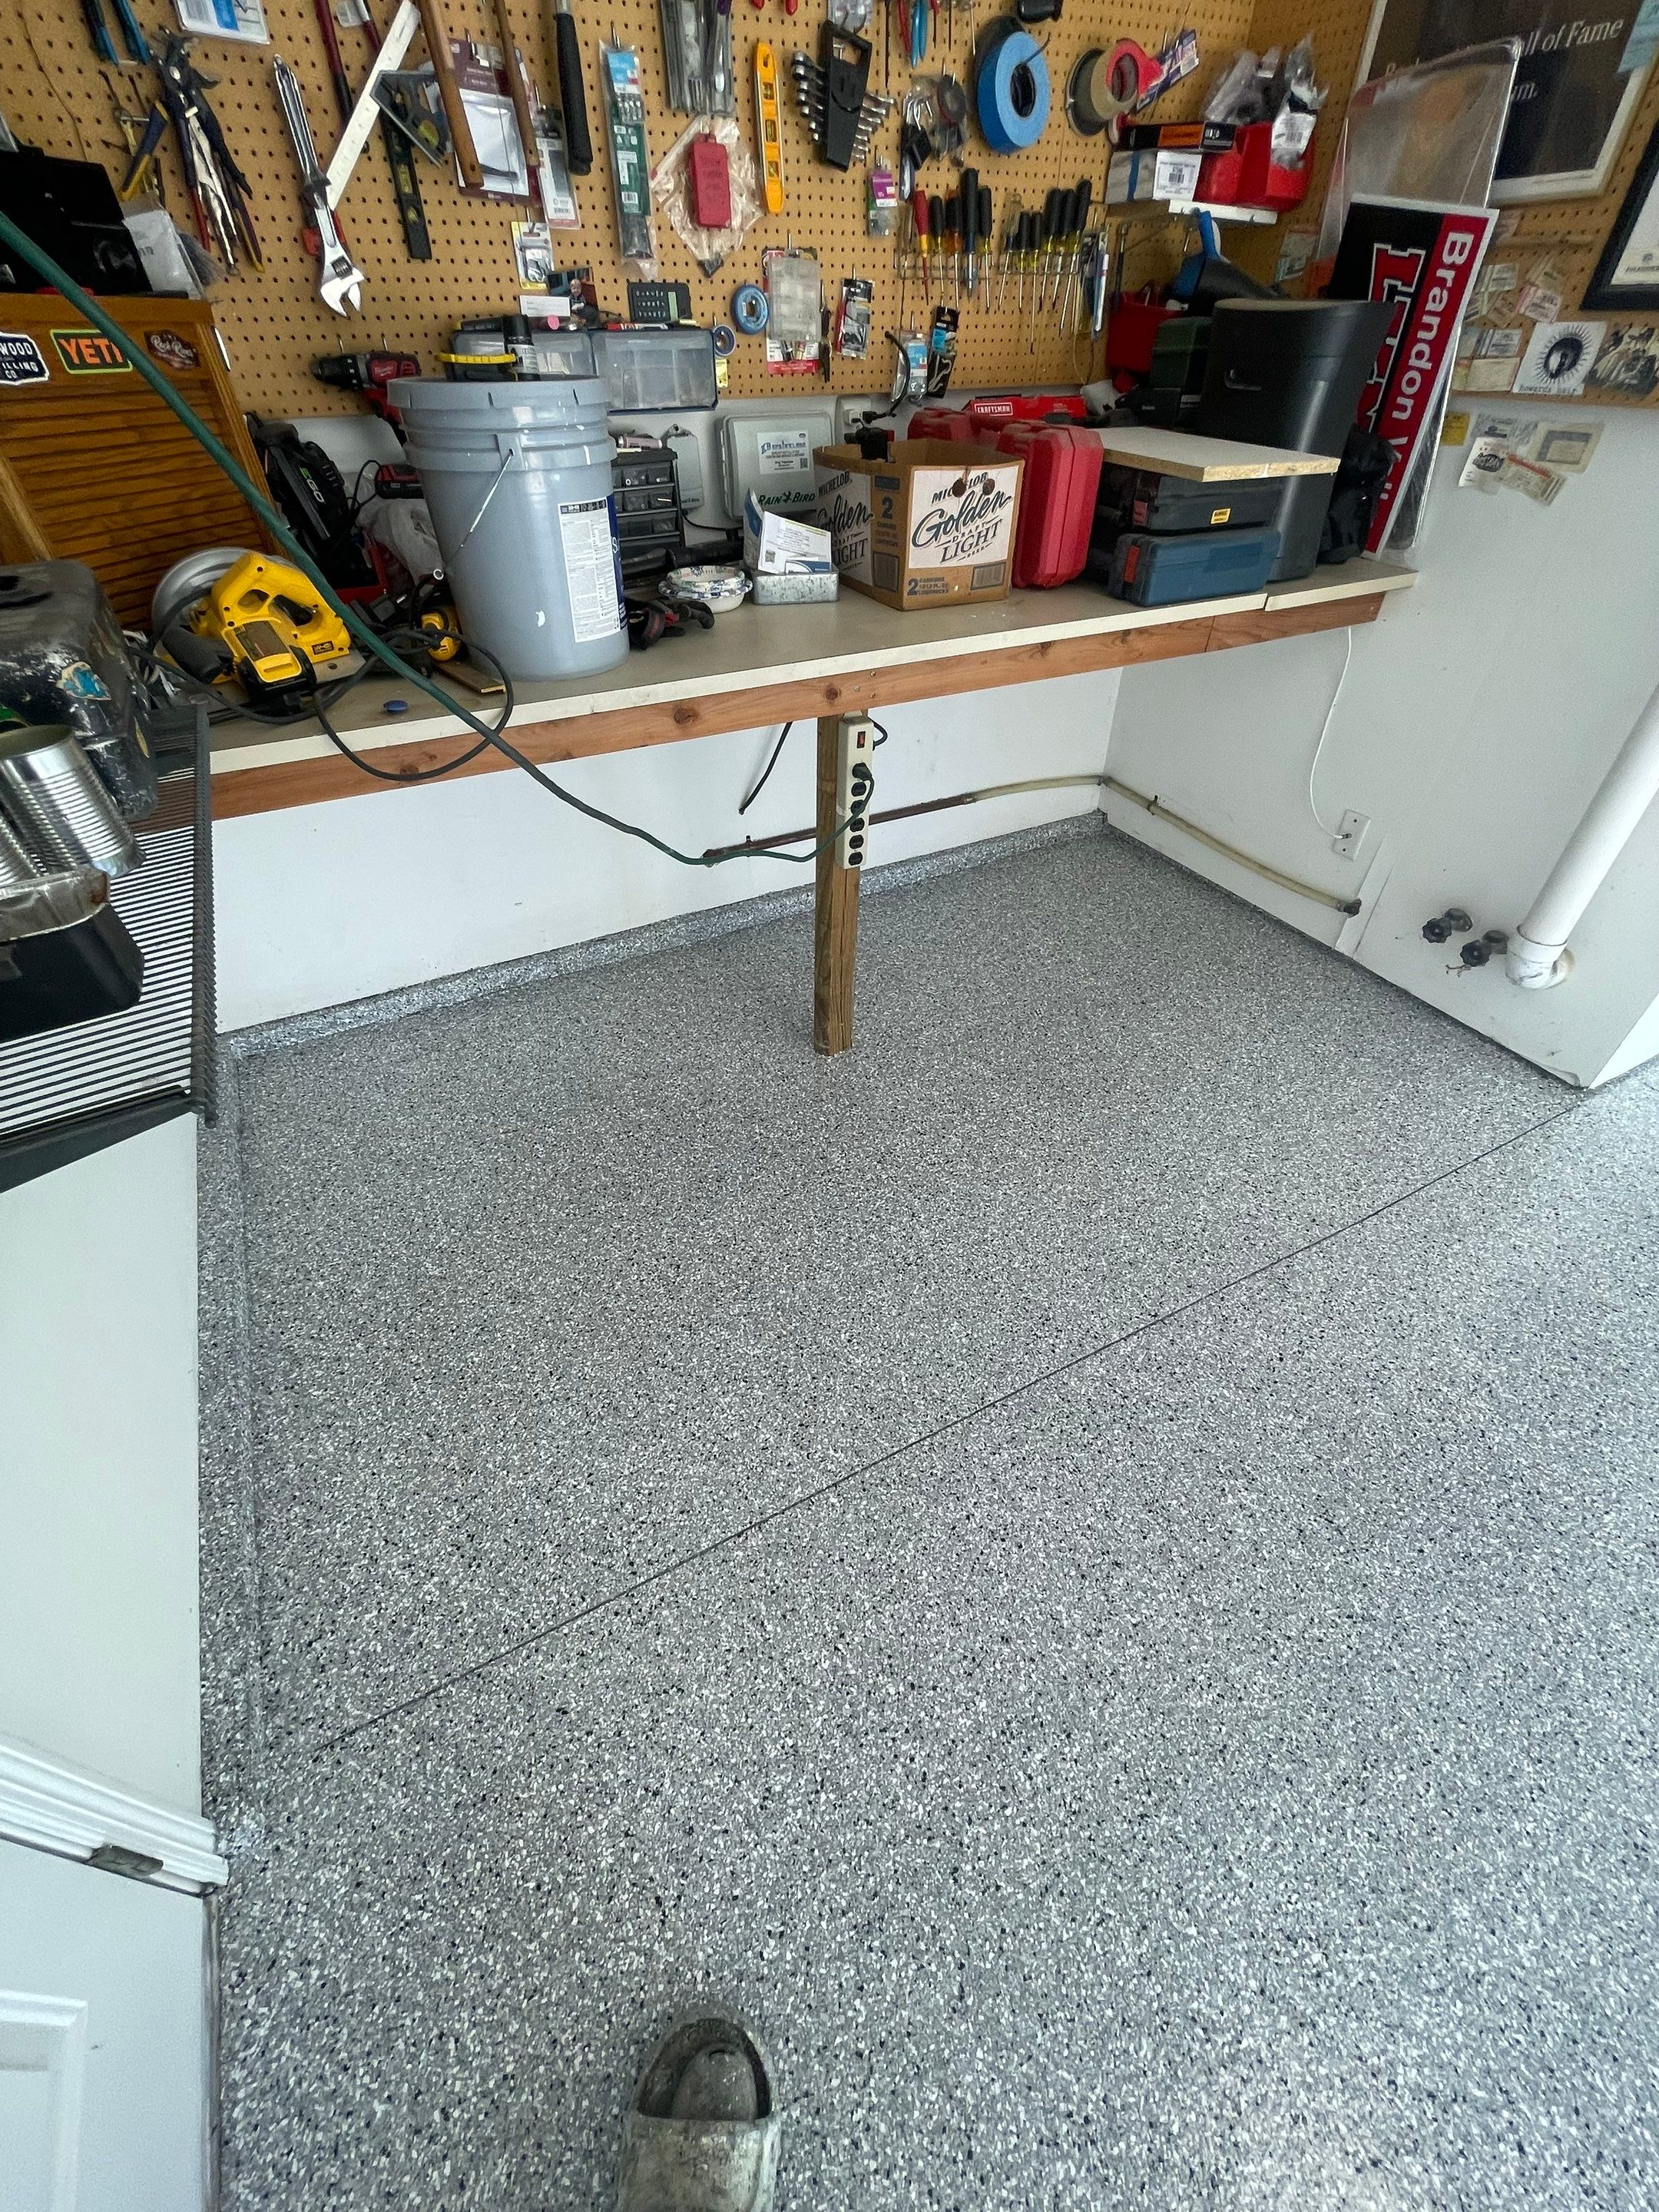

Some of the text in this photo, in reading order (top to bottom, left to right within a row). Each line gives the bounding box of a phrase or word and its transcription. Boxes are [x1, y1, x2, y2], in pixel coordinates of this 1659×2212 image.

[1543, 24, 1565, 51] of
[1565, 18, 1625, 48] Fame
[1392, 232, 1475, 420] Brandon
[58, 338, 124, 364] YETI
[977, 405, 1011, 413] CRAFTSMAN
[759, 492, 816, 505] RAIN BIRD
[932, 472, 988, 504] MICLOB
[882, 496, 893, 519] 2
[912, 490, 1012, 548] Golden
[940, 518, 1002, 564] LIGHT
[907, 578, 919, 595] 2
